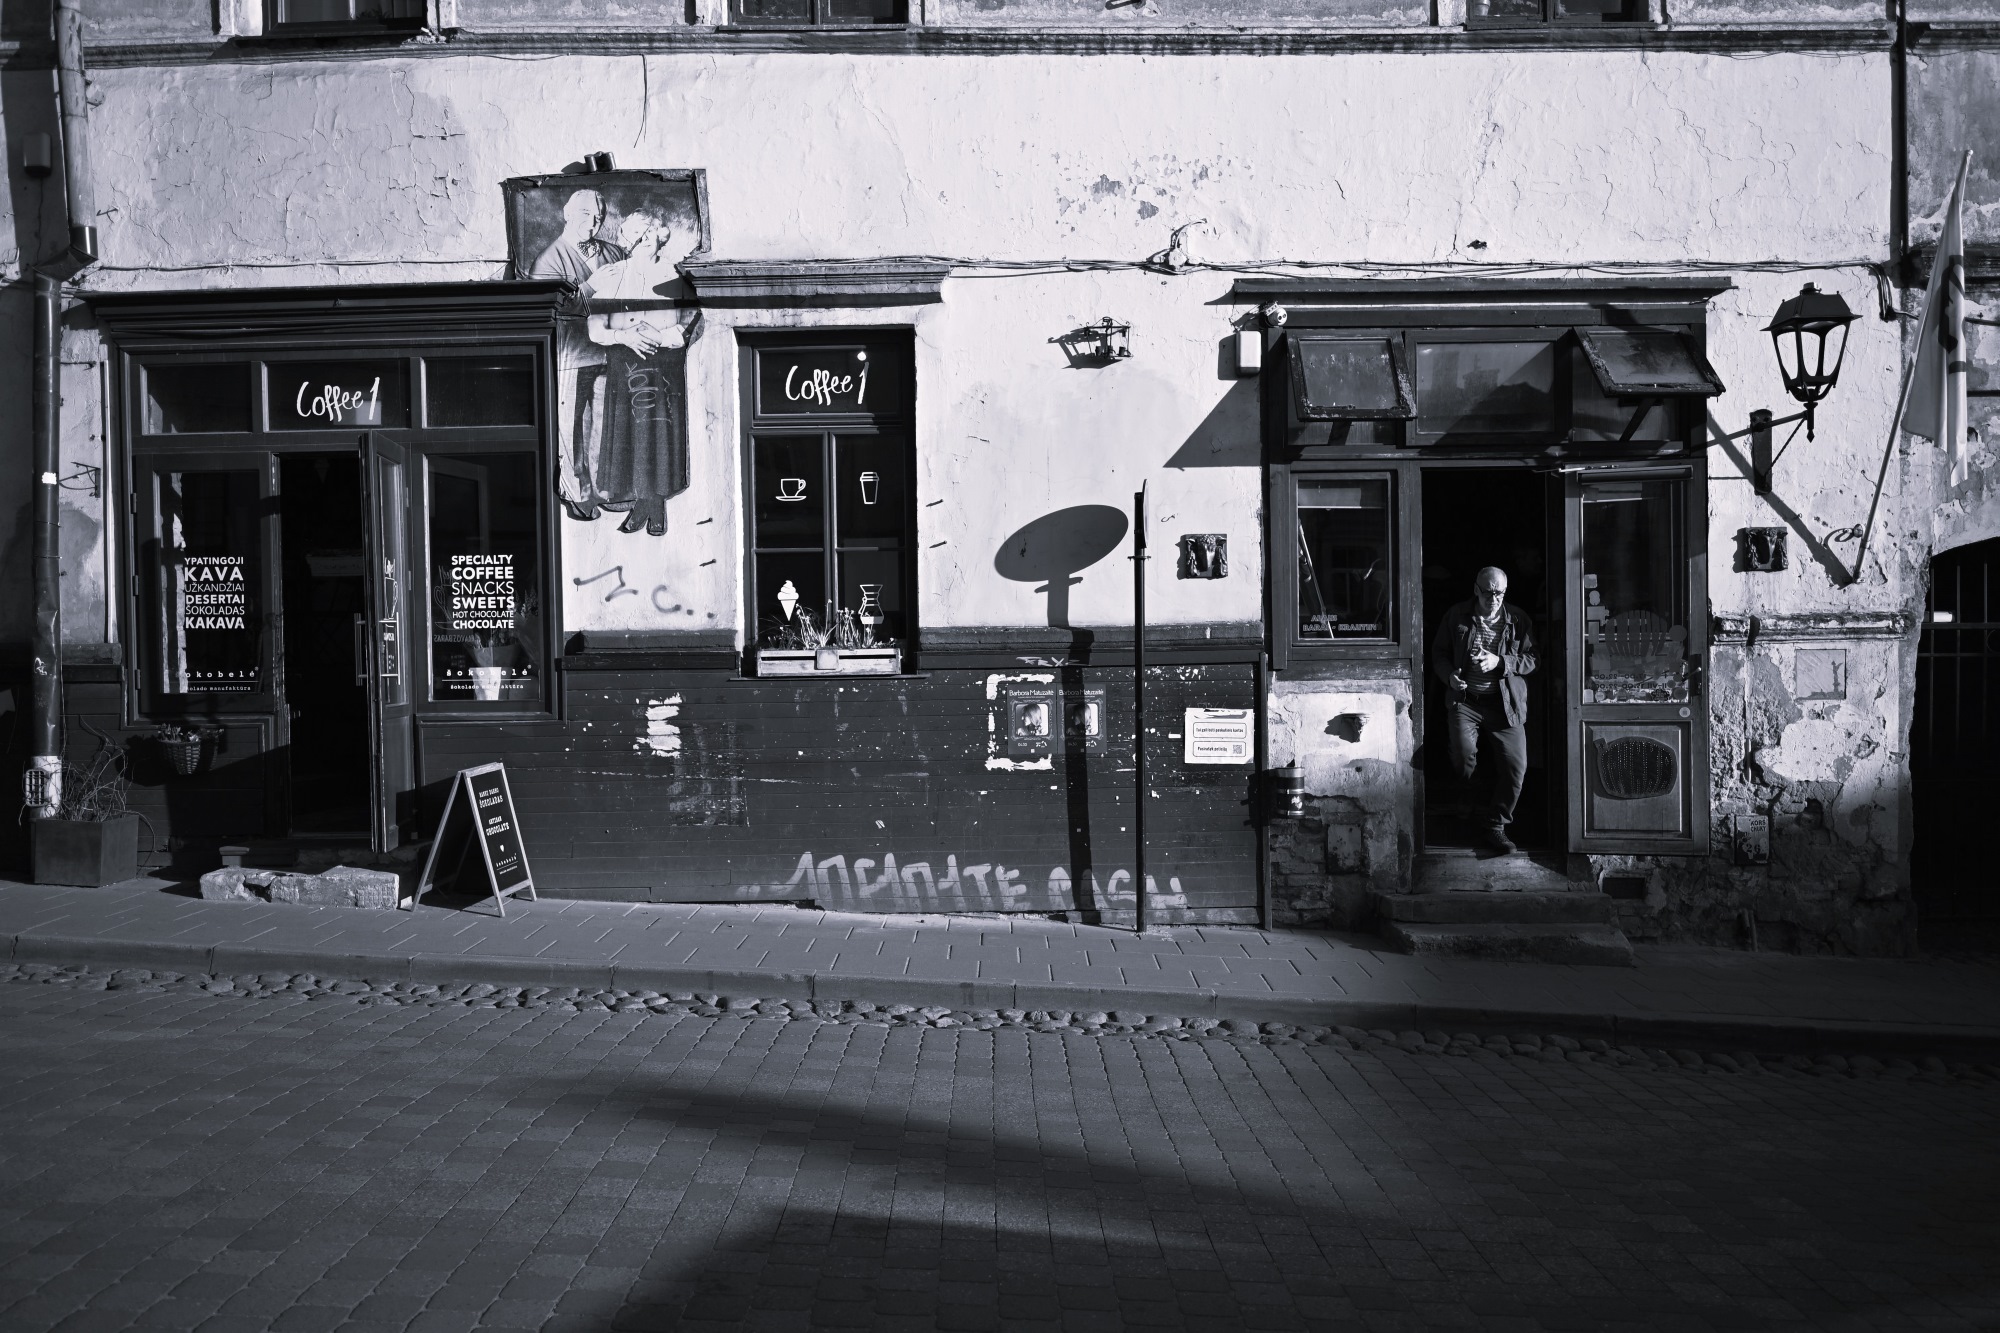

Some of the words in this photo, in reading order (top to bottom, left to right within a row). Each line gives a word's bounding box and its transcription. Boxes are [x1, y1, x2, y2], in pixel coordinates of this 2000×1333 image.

[785, 364, 854, 406] Coffee
[296, 380, 364, 423] Coffee
[184, 556, 244, 565] YPATINGOJI
[451, 554, 513, 566] SPECIALTY
[184, 567, 244, 582] KAVA
[452, 566, 514, 580] COFFEE
[184, 582, 244, 592] UŽKANDŽIAI
[452, 582, 514, 595] SNACKS
[185, 594, 244, 604] DESERTAI
[452, 596, 515, 610] SWEETS
[185, 604, 245, 616] ŠOKOLADAS
[452, 610, 468, 618] HOT
[470, 610, 514, 618] CHOCOLATE
[185, 617, 245, 630] KAKAVA
[452, 620, 514, 630] CHOCOLATE
